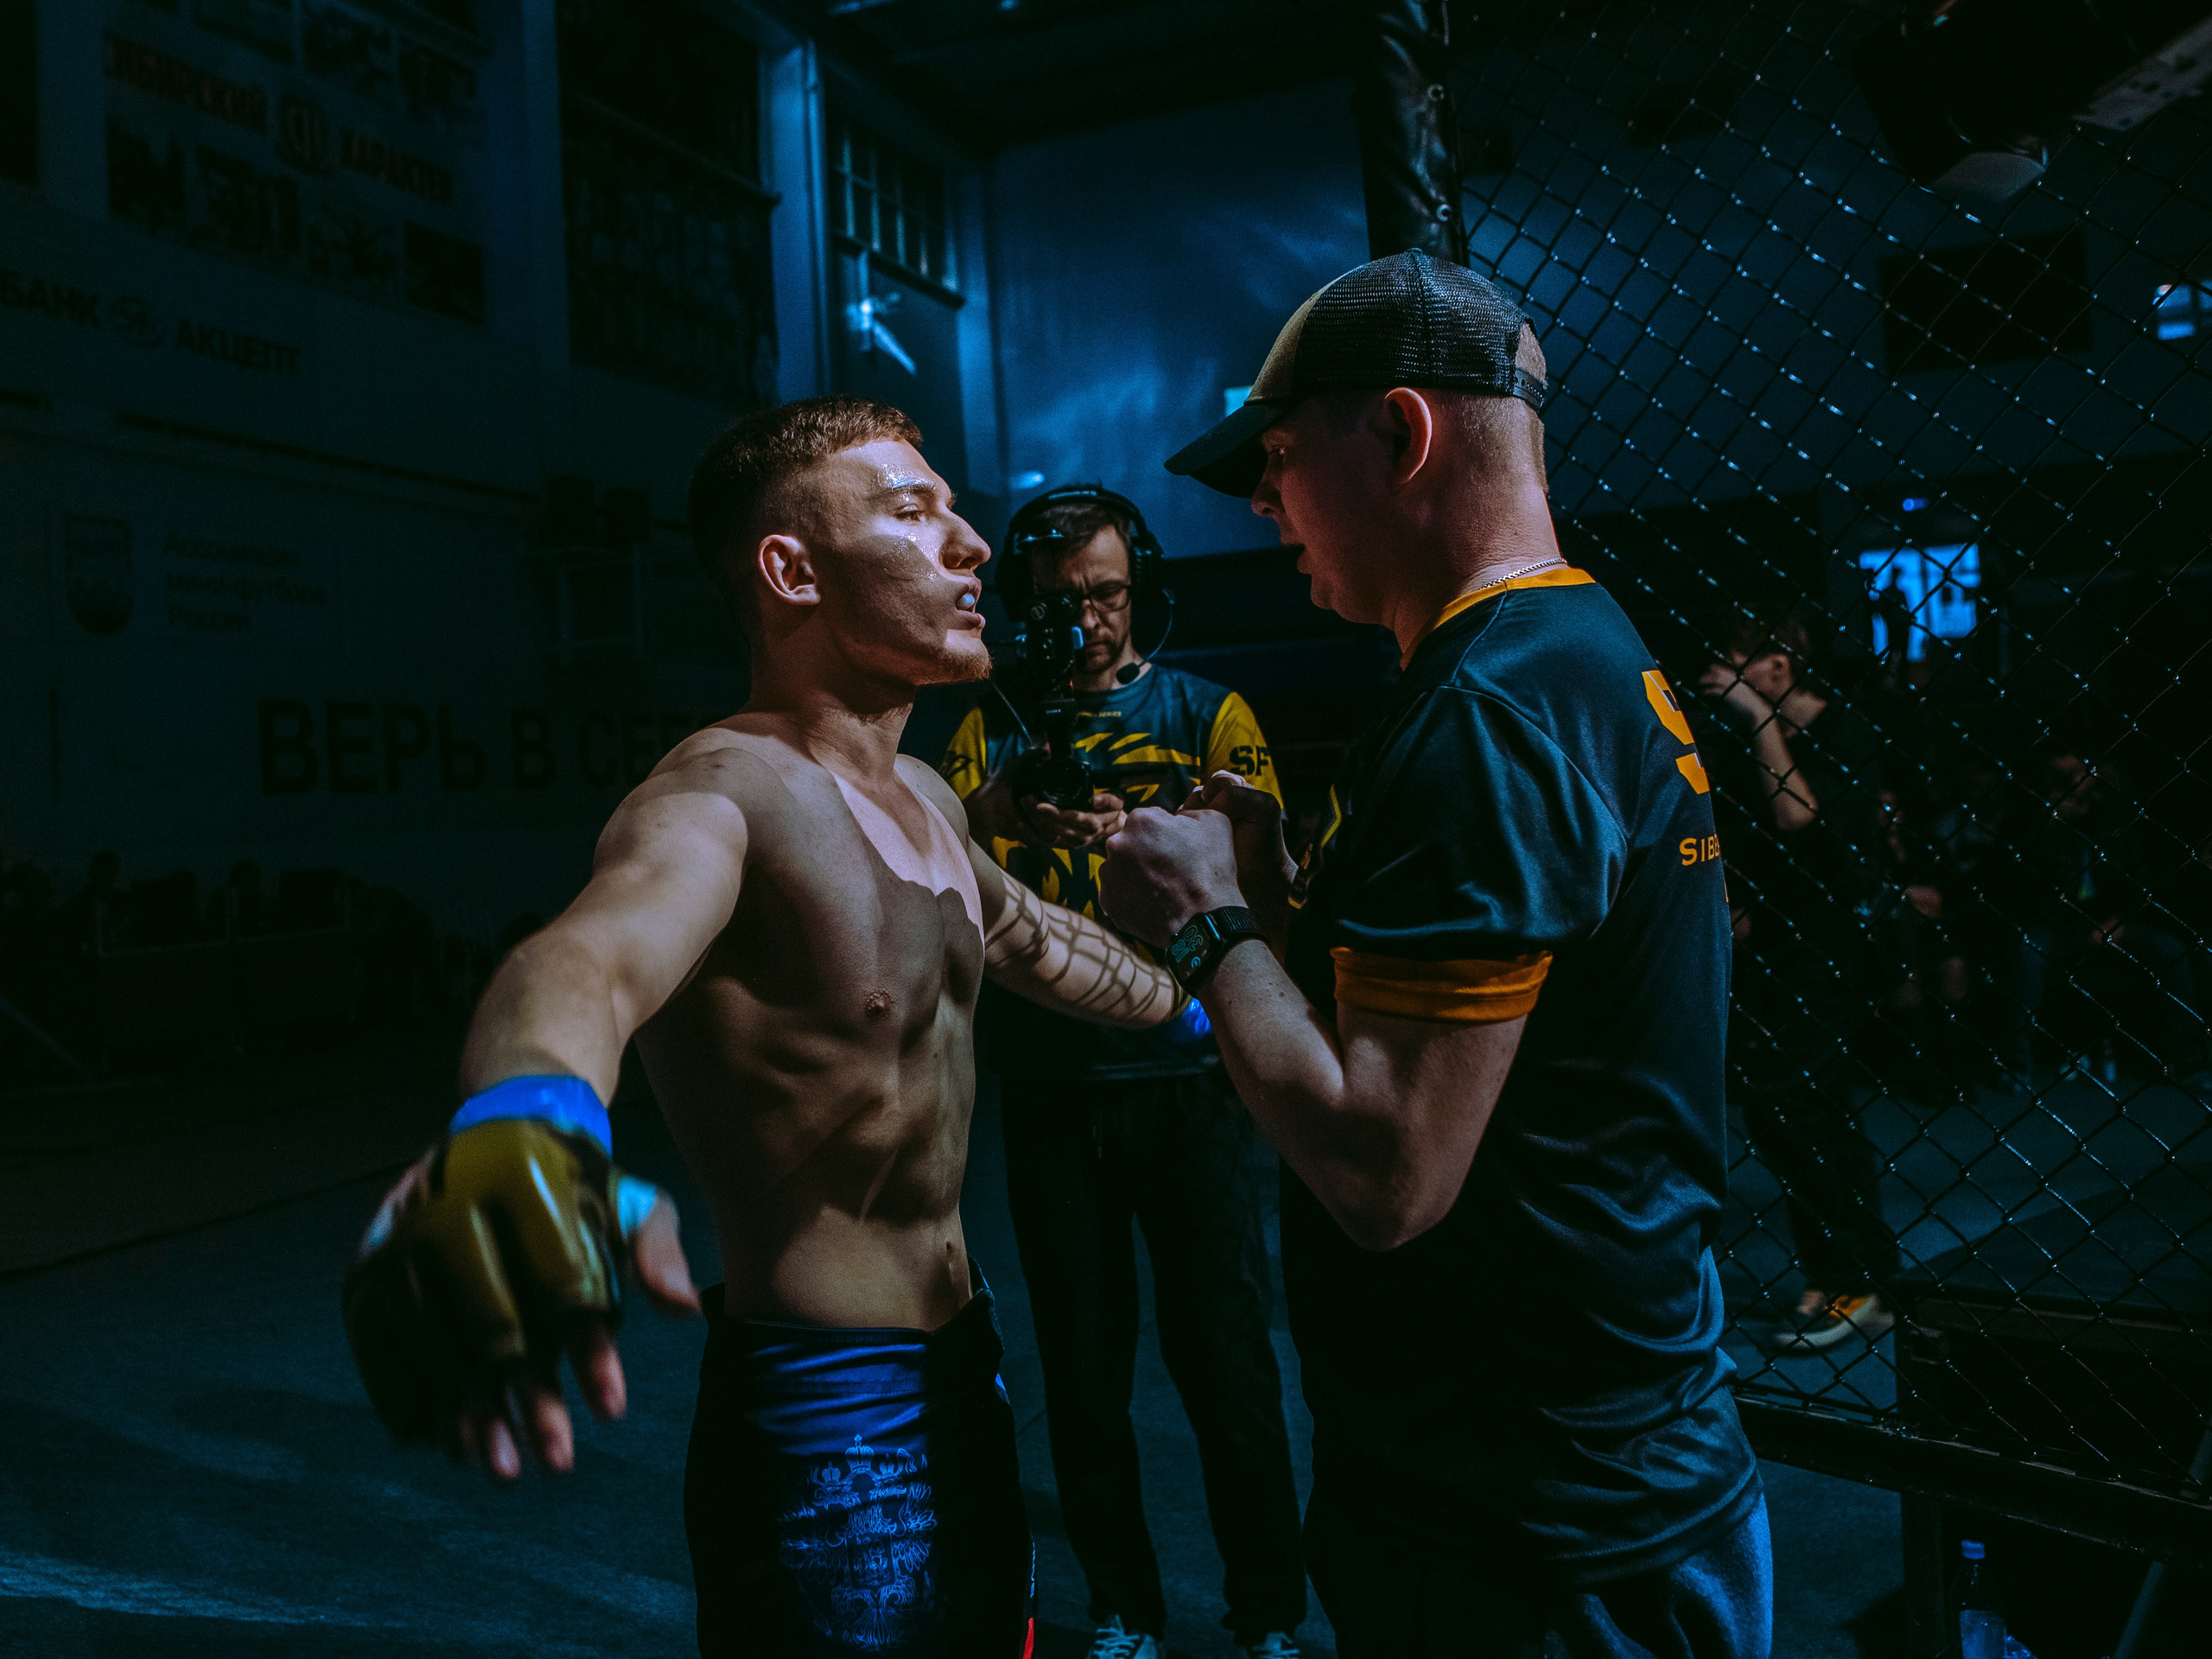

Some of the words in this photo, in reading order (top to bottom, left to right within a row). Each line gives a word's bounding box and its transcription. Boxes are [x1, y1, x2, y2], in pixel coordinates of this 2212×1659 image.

[175, 319, 301, 376] АКЦЕПТ
[257, 698, 487, 796] ВЕРЬ
[511, 707, 556, 790] В
